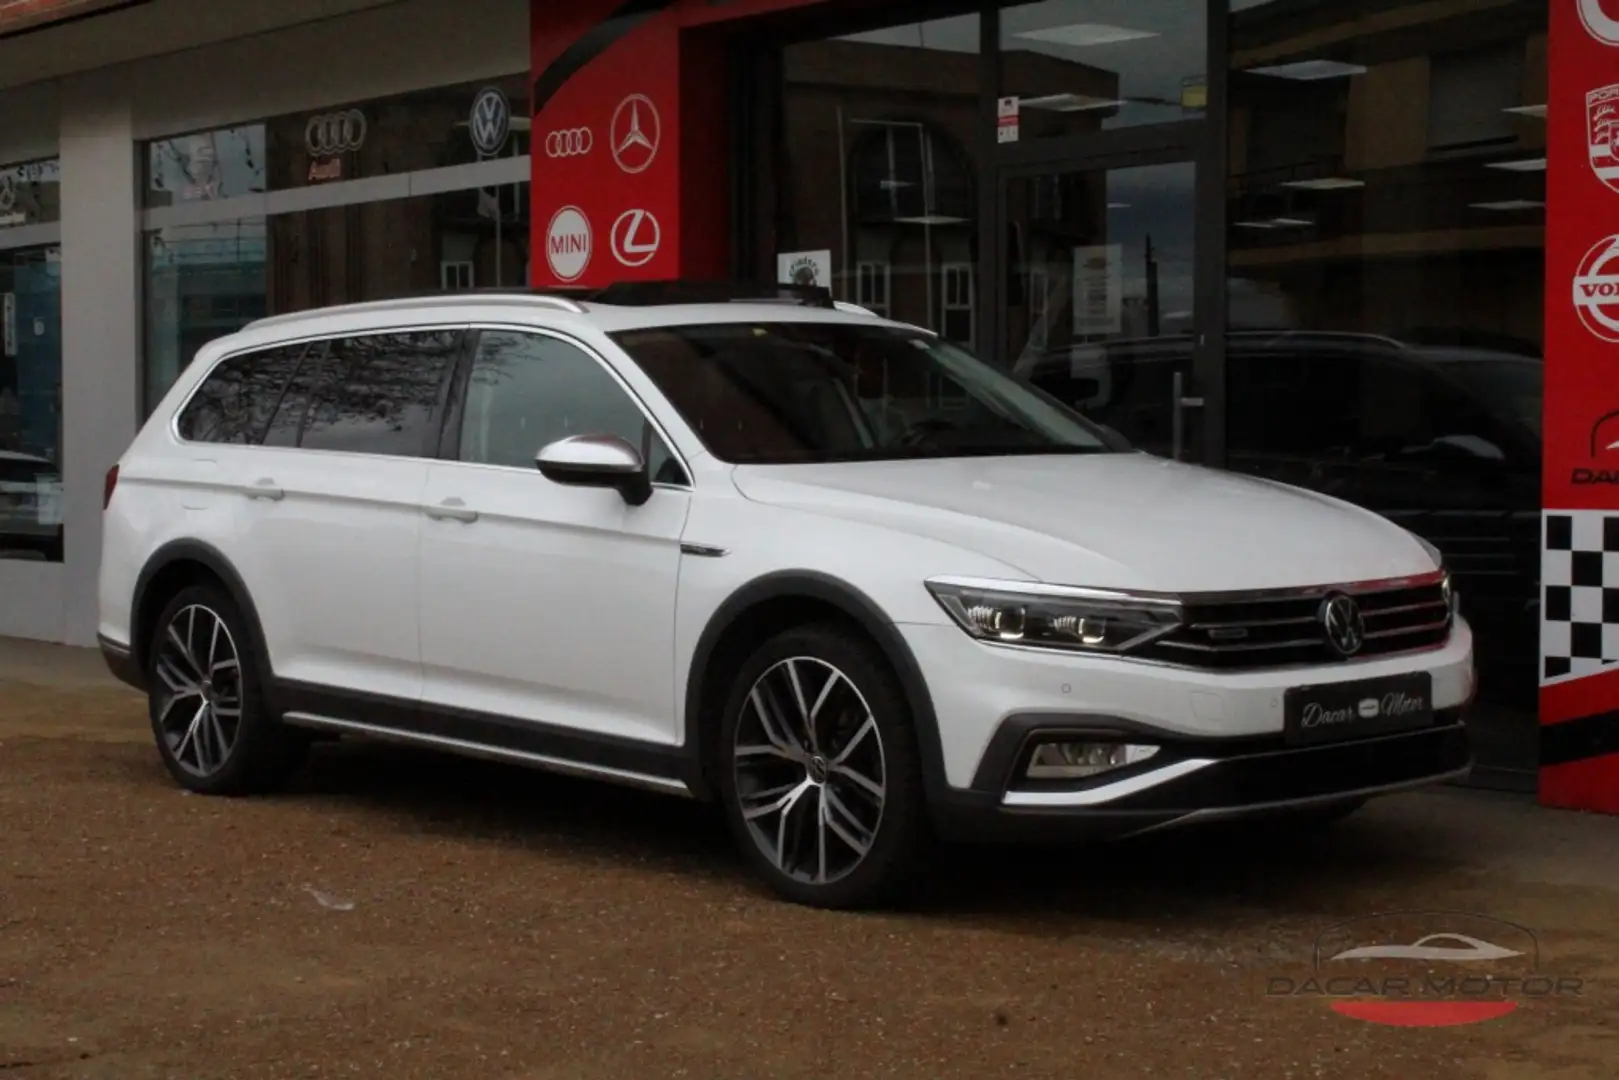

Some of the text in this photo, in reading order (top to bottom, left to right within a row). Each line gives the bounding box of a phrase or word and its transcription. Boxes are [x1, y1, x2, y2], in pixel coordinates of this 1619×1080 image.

[551, 233, 587, 255] MINI
[1301, 692, 1424, 728] Dacar Motor
